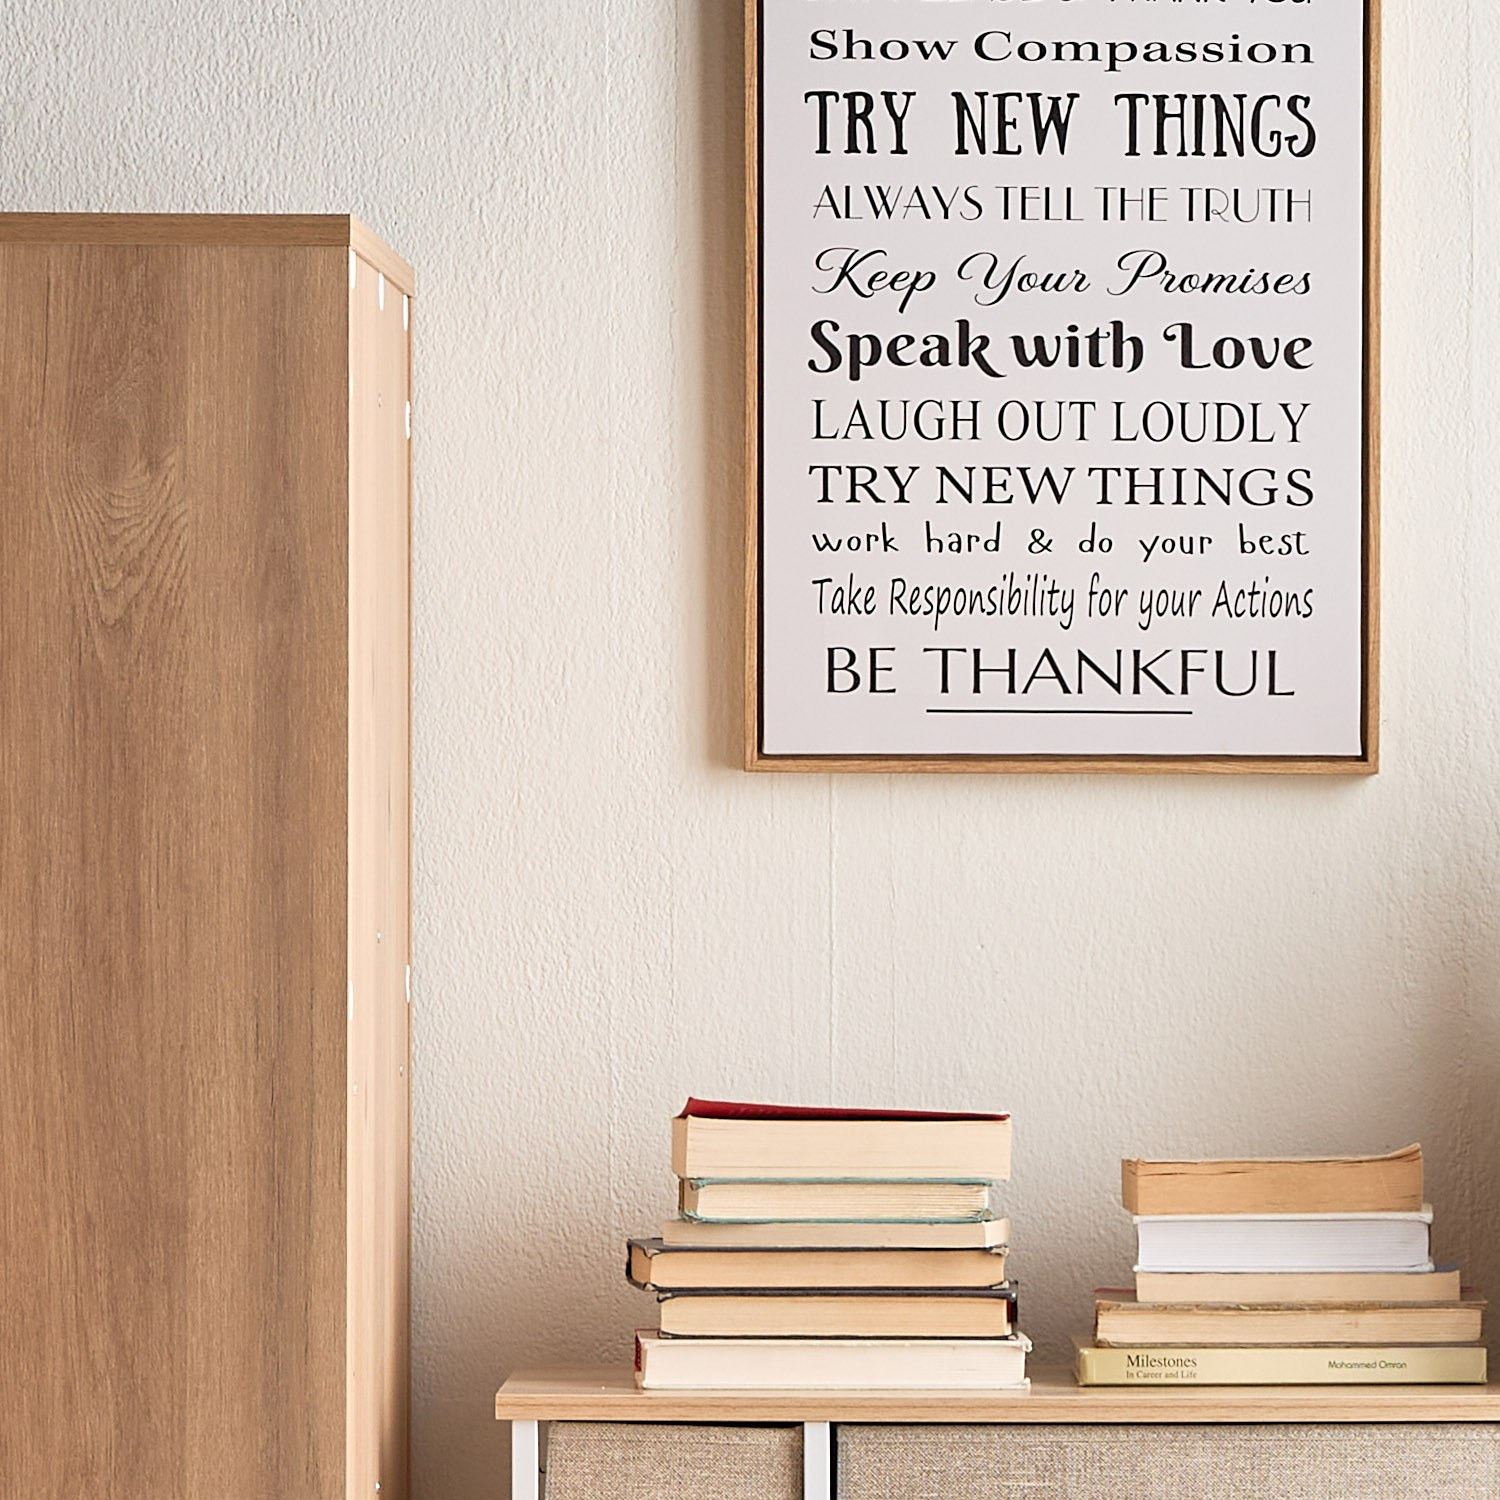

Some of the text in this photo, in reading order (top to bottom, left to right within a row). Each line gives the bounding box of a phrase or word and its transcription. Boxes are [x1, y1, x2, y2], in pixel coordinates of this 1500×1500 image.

[810, 29, 1314, 72] Show Compassion
[804, 91, 1316, 157] TRY NEW THINGS
[813, 185, 1310, 222] ALWAYS TELL THE TRUTH
[812, 248, 1310, 313] Keep Your Promises
[808, 319, 1313, 381] Speak with Love
[812, 400, 1310, 442] LAUGH OUT LOUDLY
[809, 466, 1313, 506] TRY NEW THINGS
[812, 521, 1309, 562] work hard & do your best
[812, 572, 1313, 631] Take Responsibility for your Actions
[827, 647, 1294, 696] BE THANKFUL
[1126, 1370, 1197, 1379] In Career and Life
[1127, 1354, 1197, 1367] Milestones
[1328, 1360, 1377, 1369] Mohammed
